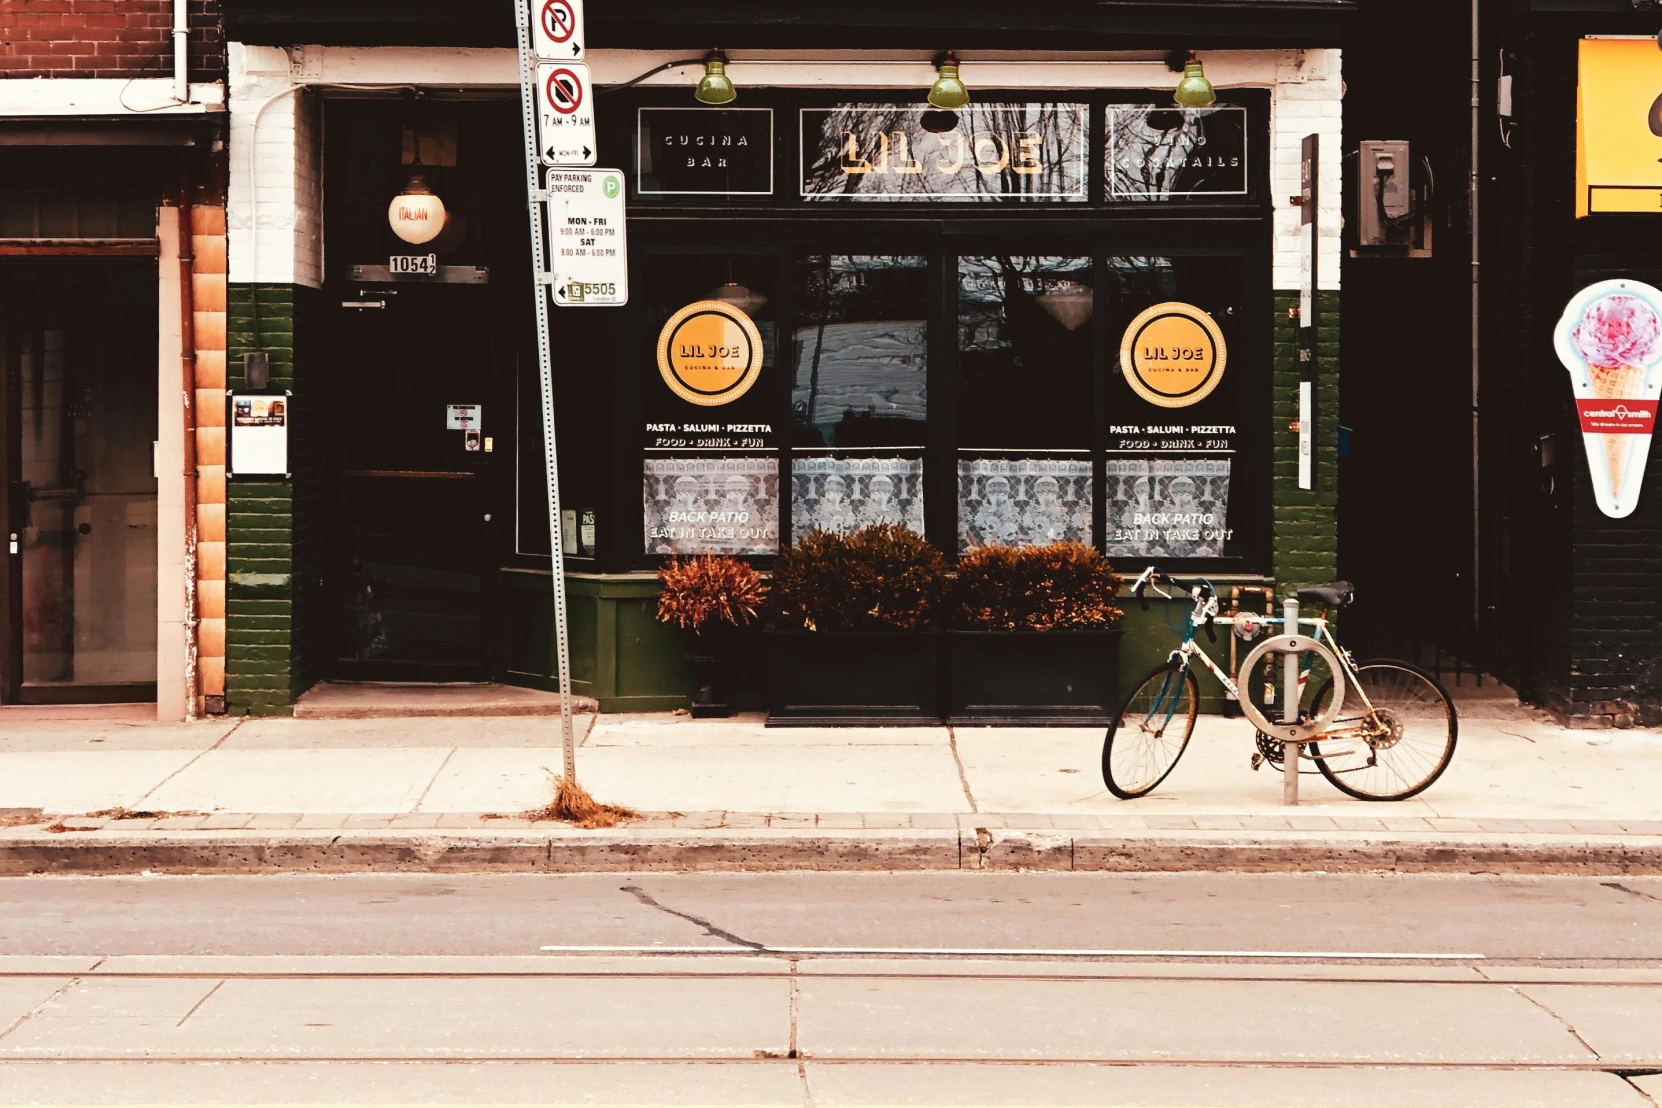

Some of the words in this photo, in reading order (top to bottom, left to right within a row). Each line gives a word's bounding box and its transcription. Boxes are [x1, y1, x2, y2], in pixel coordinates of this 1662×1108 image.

[543, 114, 549, 127] 7
[552, 117, 563, 127] AM
[571, 114, 577, 127] 9
[580, 117, 590, 127] AM
[665, 135, 748, 146] CUCINA
[1153, 134, 1207, 146] VINO
[840, 131, 923, 174] LIL
[936, 131, 1044, 174] JOE
[686, 157, 727, 167] BAR
[1120, 157, 1239, 168] COCKTAILS
[551, 173, 563, 182] PAY
[564, 174, 592, 183] PARKING
[551, 184, 584, 193] ENFORCED
[398, 206, 428, 221] ITALIAN
[567, 217, 587, 225] MON
[593, 218, 607, 226] FRI
[560, 228, 573, 236] 9:00
[574, 228, 585, 236] AM
[591, 228, 604, 236] 6:00
[605, 228, 615, 236] PM
[580, 238, 596, 246] SAT
[575, 249, 586, 257] AM
[605, 249, 616, 257] PM
[584, 283, 616, 295] 5505
[680, 344, 704, 358] LIL
[707, 344, 740, 358] JOE
[1144, 347, 1168, 360] LIL
[1172, 347, 1204, 360] JOE
[1583, 409, 1615, 418] central
[1627, 410, 1652, 418] smith
[646, 423, 676, 432] PASTA
[683, 424, 719, 432] SALUMI
[727, 424, 772, 433] PIZZETTA
[1110, 425, 1140, 433] PASTA
[1147, 425, 1183, 433] SALUMI
[1191, 425, 1236, 433] PIZZETTA
[656, 437, 686, 446] FOOD
[696, 438, 731, 447] DRINK
[740, 438, 764, 447] FUN
[1119, 439, 1150, 448] FOOD
[1160, 439, 1195, 448] DRINK
[1205, 439, 1228, 448] FUN
[583, 514, 595, 525] PAS
[669, 511, 705, 523] BACK
[709, 511, 749, 523] PATIO
[1133, 513, 1170, 524] BACK
[1173, 513, 1214, 524] PATIO
[650, 527, 676, 538] EAT
[680, 527, 695, 538] IN
[699, 527, 735, 539] TAKE
[740, 527, 768, 539] OUT
[1114, 529, 1140, 540] EAT
[1144, 529, 1159, 540] IN
[1163, 529, 1200, 540] TAKE
[1203, 529, 1234, 540] OUT
